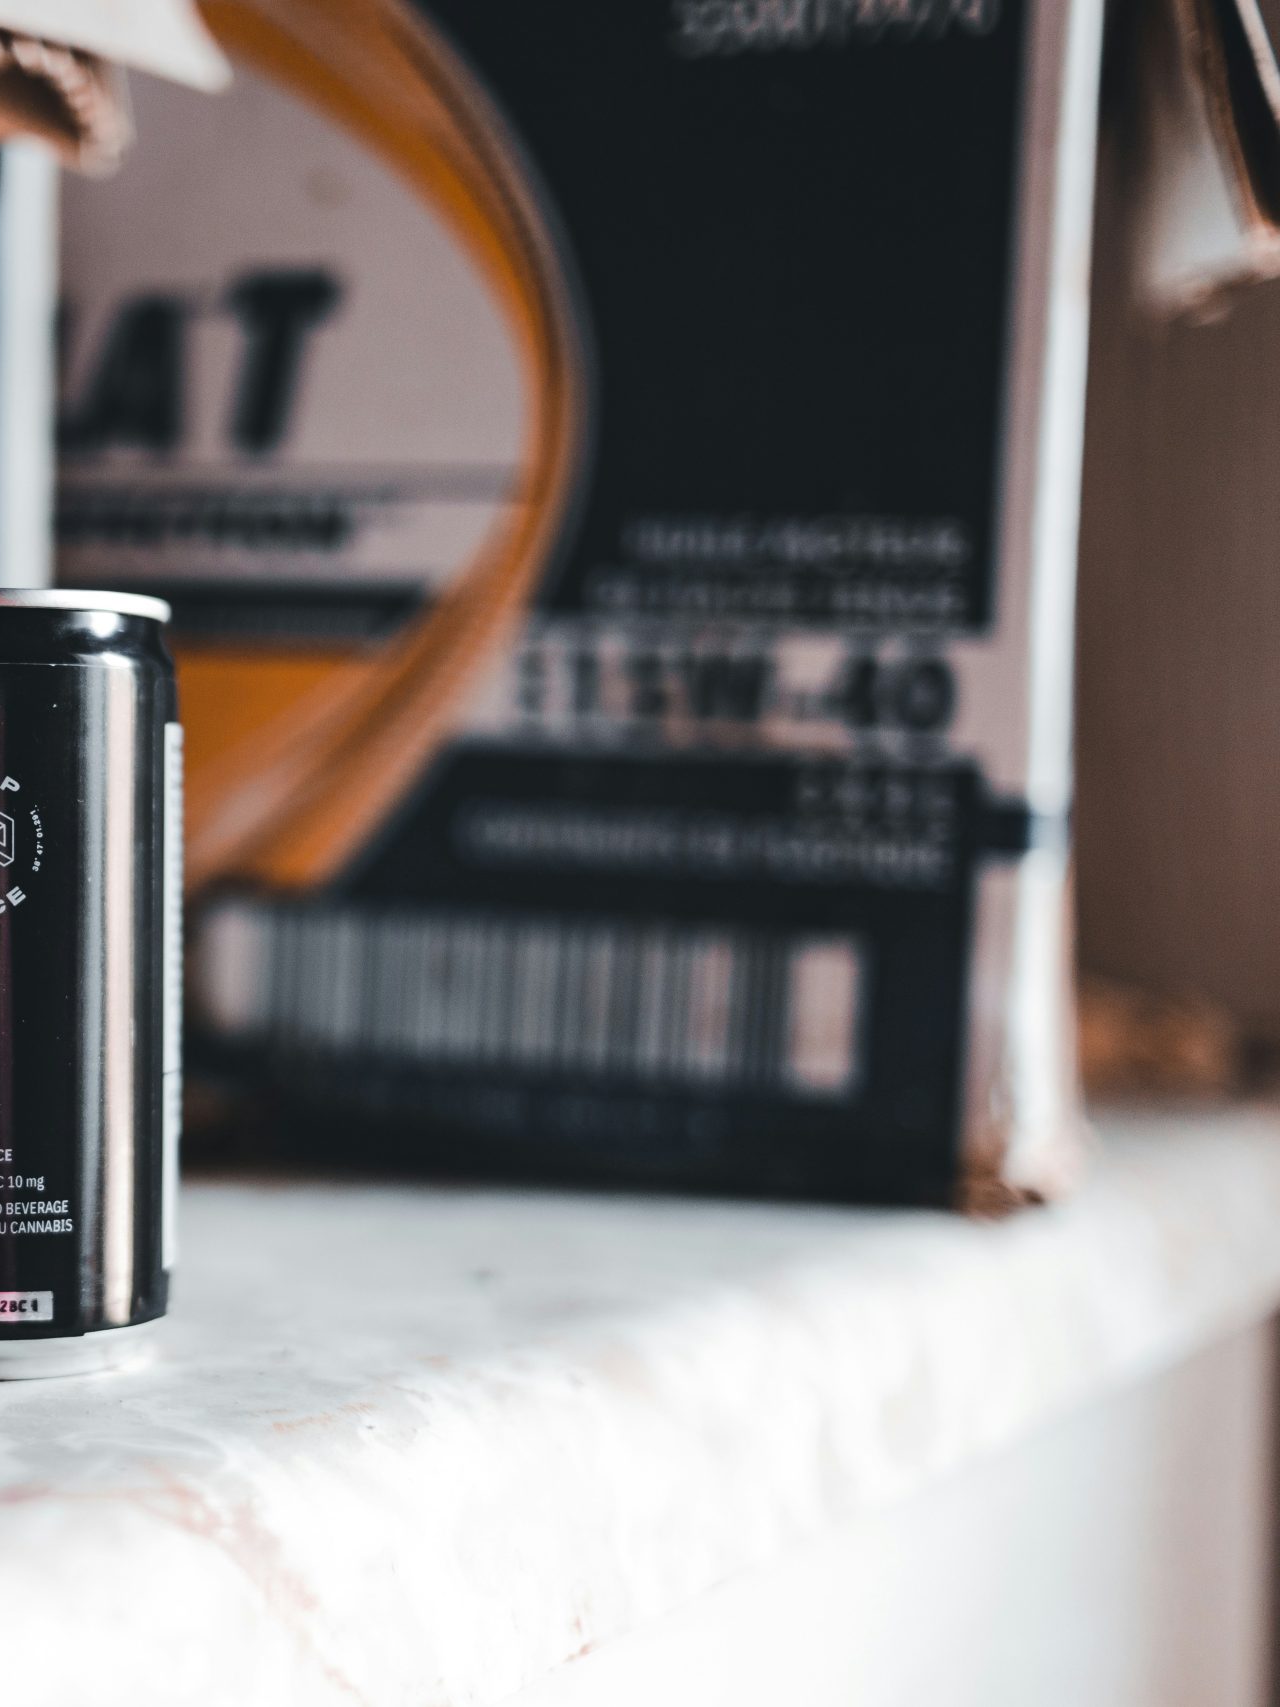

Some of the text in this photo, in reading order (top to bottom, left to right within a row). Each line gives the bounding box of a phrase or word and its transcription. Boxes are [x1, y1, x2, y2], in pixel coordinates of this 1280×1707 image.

[7, 1175, 23, 1188] 10
[26, 1177, 45, 1191] mg
[6, 1200, 69, 1215] BEVERAGE
[10, 1218, 73, 1234] CANNABIS
